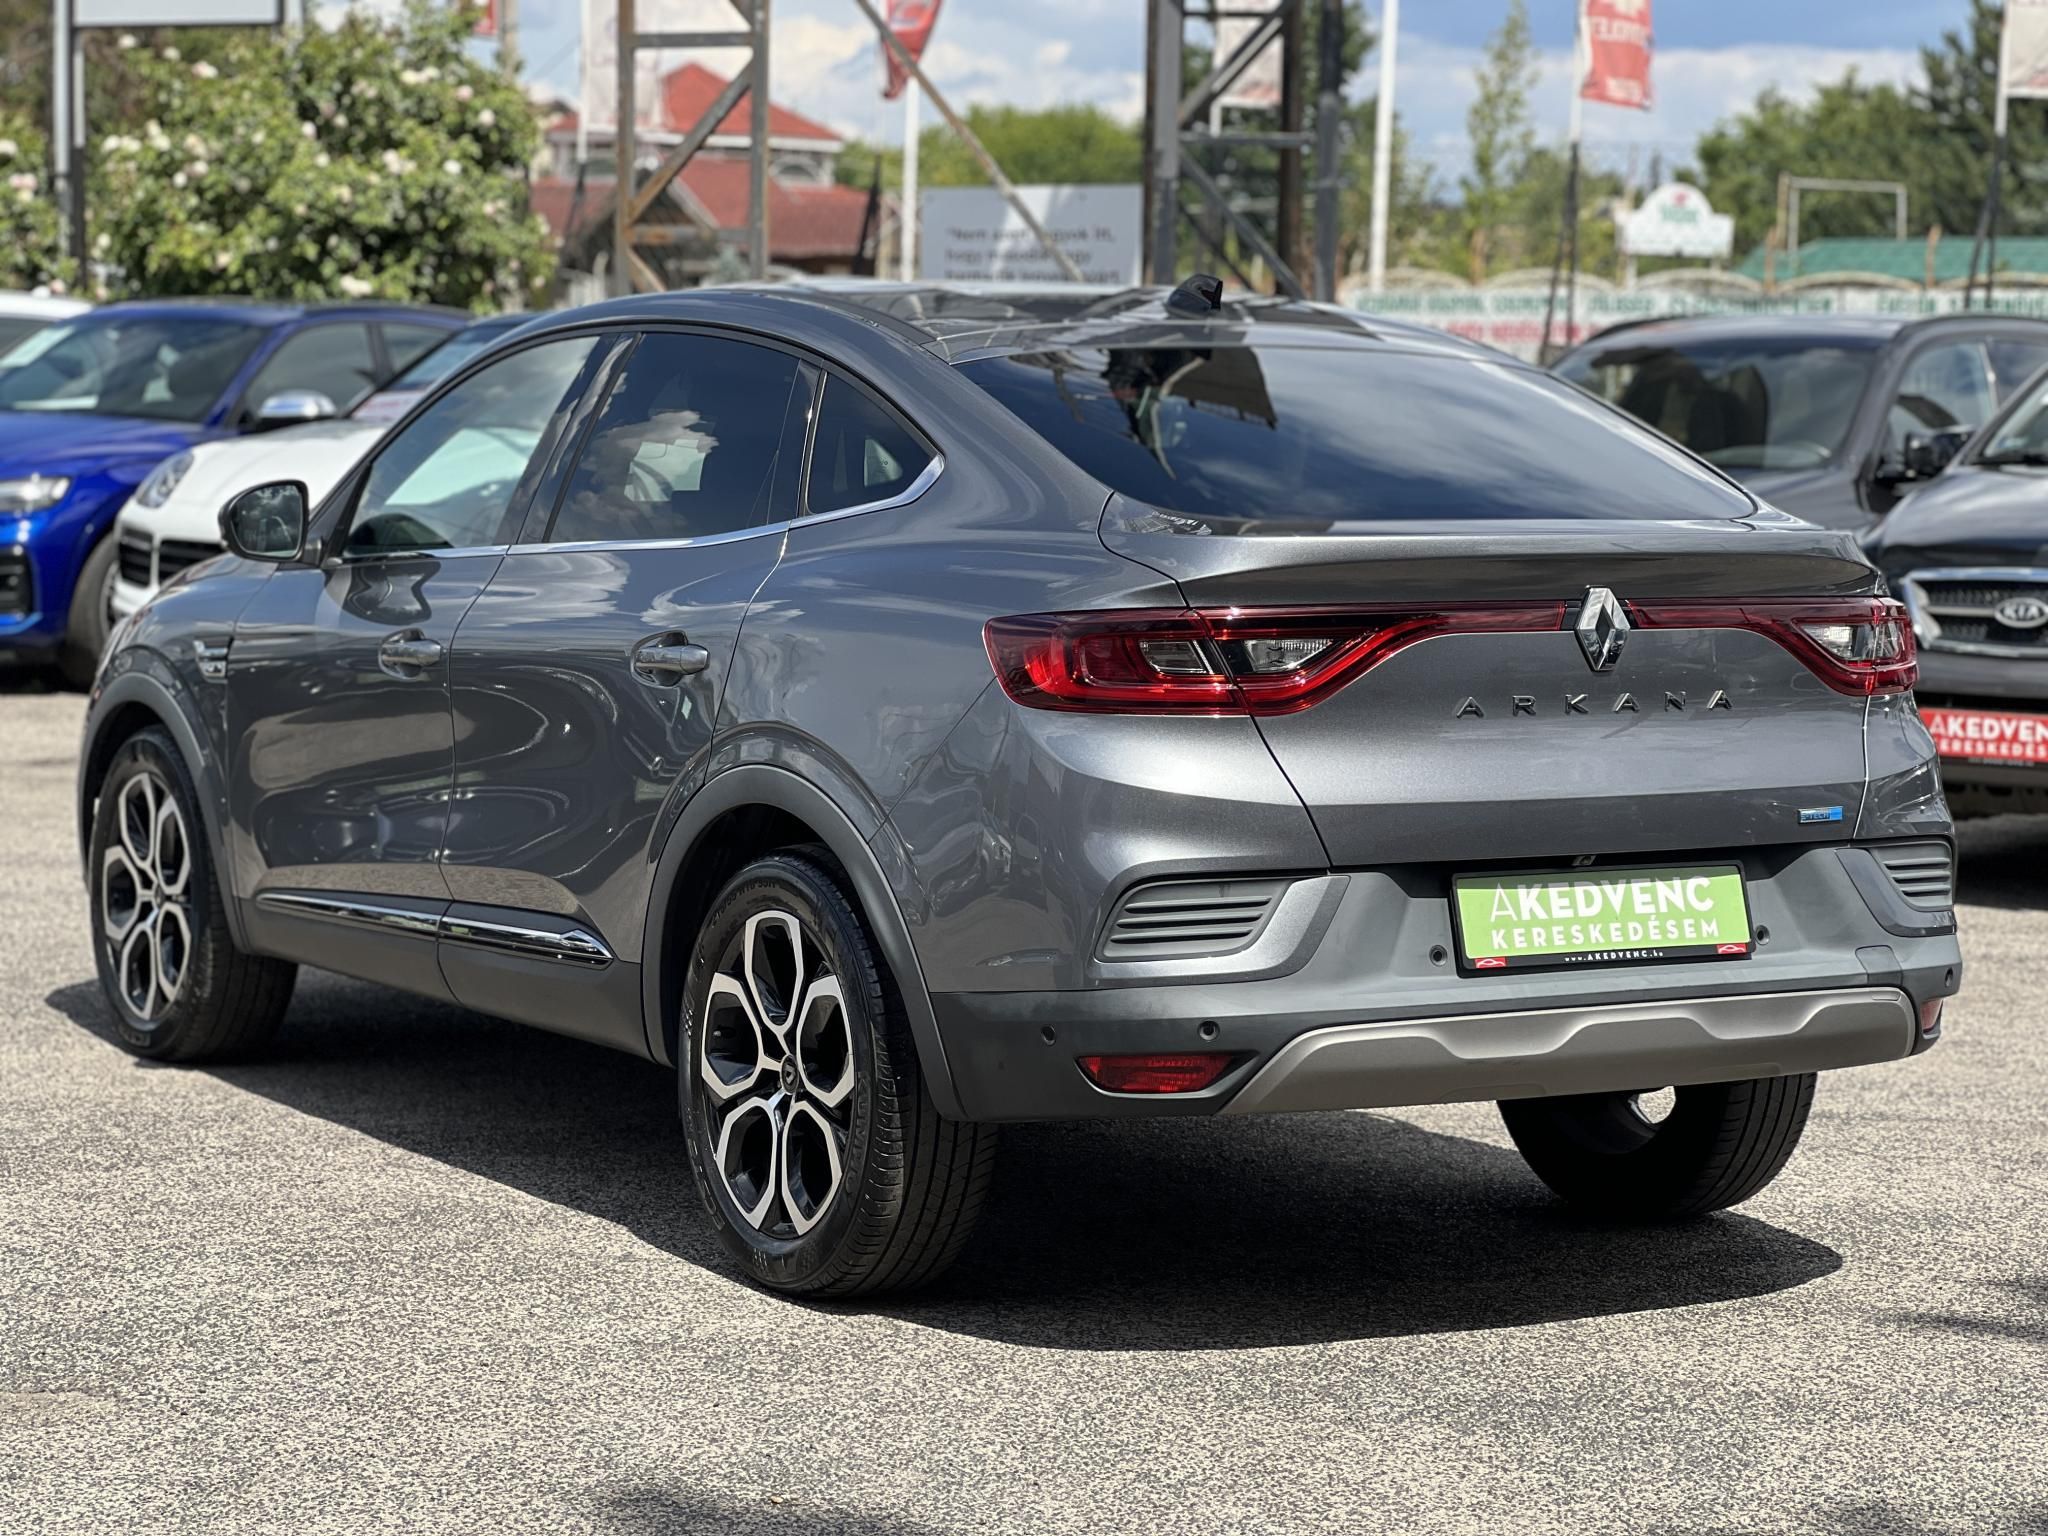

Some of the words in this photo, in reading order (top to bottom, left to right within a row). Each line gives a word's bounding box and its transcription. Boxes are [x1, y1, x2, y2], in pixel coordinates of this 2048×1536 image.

[1456, 690, 1734, 719] ARKANA
[1490, 875, 1714, 922] AKEDVENC
[1492, 914, 1720, 949] KERESKEDÉSEM
